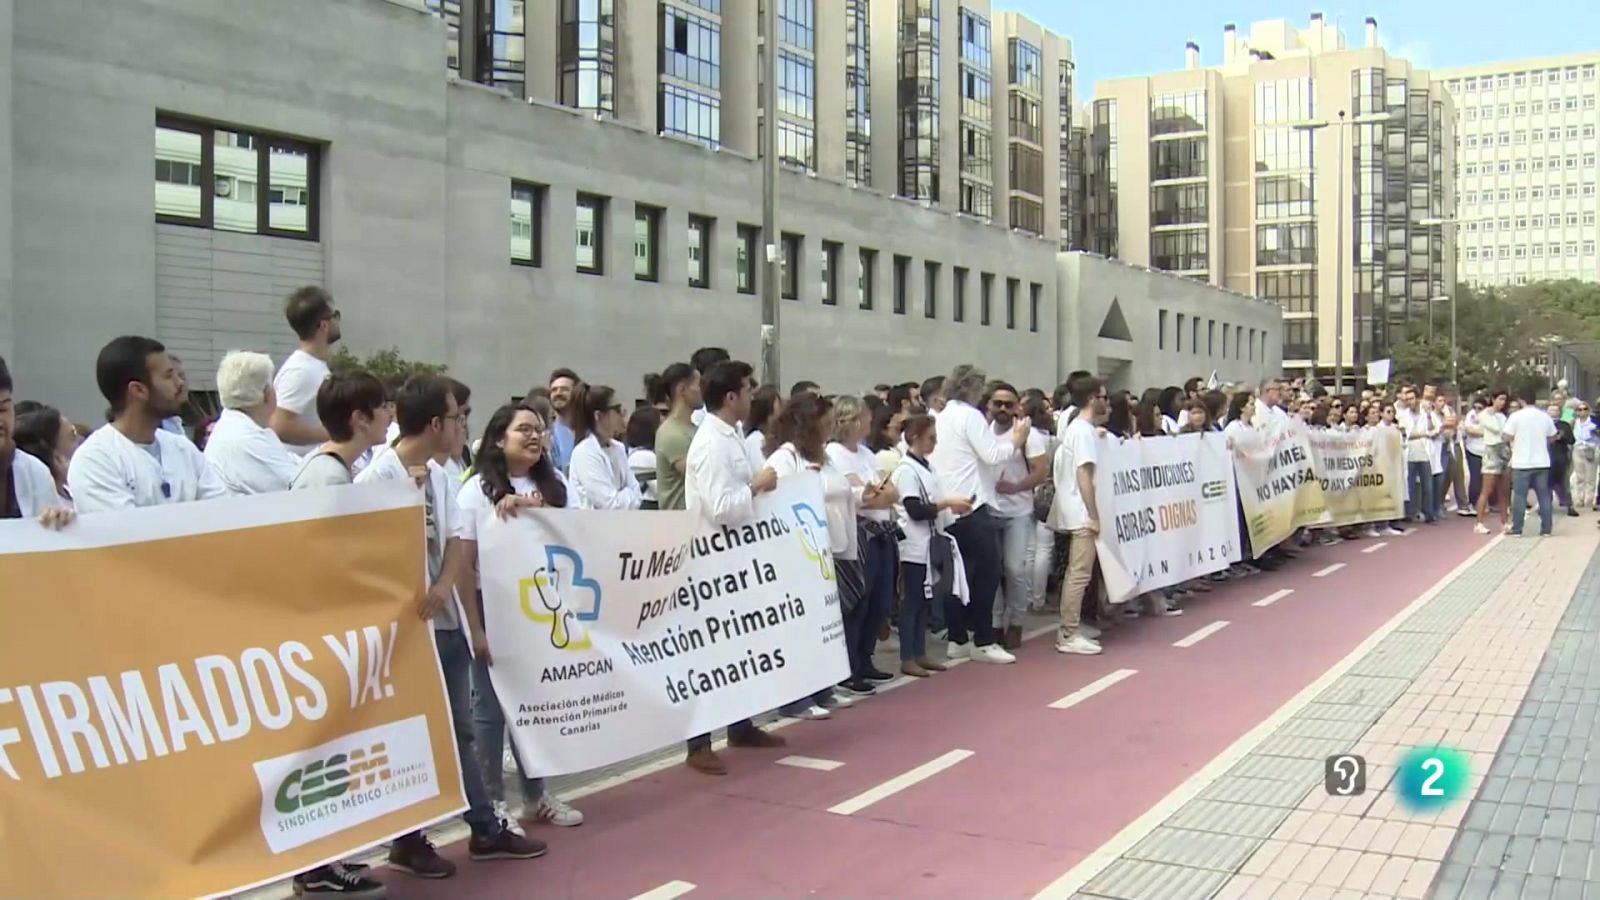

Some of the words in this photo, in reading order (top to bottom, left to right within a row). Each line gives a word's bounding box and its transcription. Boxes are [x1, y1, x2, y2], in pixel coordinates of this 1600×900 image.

[1158, 499, 1198, 532] DIGNAS
[619, 552, 644, 581] Tu
[637, 595, 669, 630] por
[752, 558, 777, 585] la
[622, 624, 705, 667] Atención
[705, 593, 806, 643] Primaria
[322, 621, 398, 709] YA!
[540, 658, 614, 684] AMAPCAN
[665, 675, 690, 704] de
[688, 649, 786, 697] Canarias
[515, 717, 531, 728] de
[532, 711, 581, 727] Atención
[582, 703, 618, 720] Primaria
[618, 701, 629, 711] de
[518, 699, 579, 714] Asociación
[580, 696, 592, 707] de
[592, 690, 625, 704] Médicos
[560, 721, 601, 737] Canarias
[274, 742, 392, 814] CESM
[278, 802, 339, 832] SINDICATO
[384, 772, 430, 796] CANARIO
